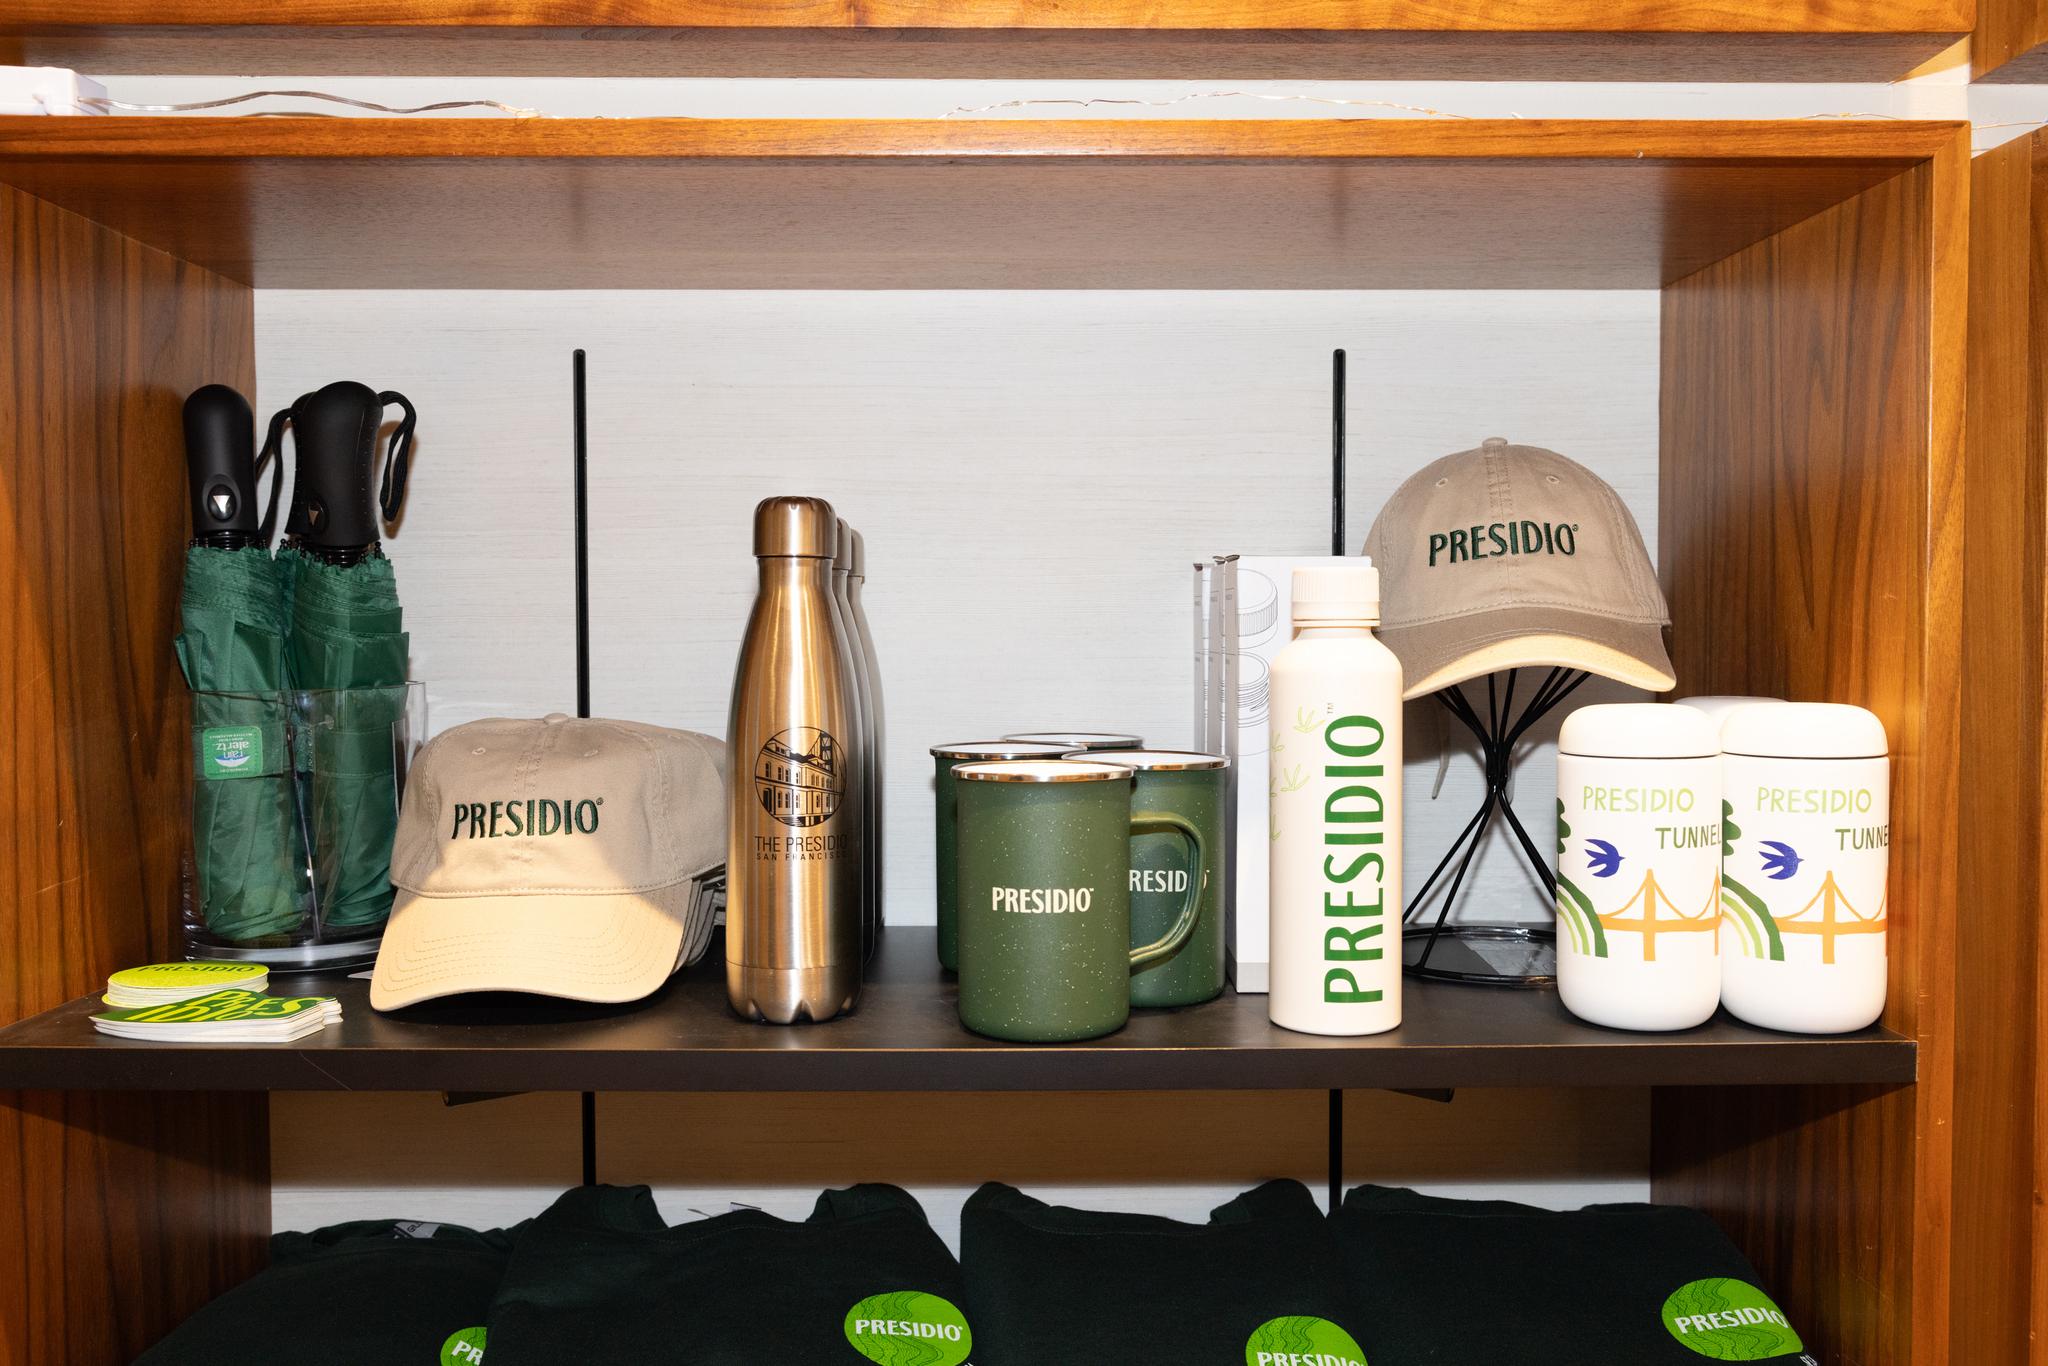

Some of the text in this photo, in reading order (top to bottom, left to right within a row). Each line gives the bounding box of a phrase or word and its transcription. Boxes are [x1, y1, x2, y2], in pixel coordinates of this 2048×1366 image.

[1583, 786, 1694, 813] PRESIDIO
[1757, 786, 1872, 814] PRESIDIO
[755, 835, 781, 852] THE
[1835, 824, 1888, 851] TUNNE
[756, 852, 776, 861] SAN
[1324, 715, 1384, 1003] PRESIDIO
[1129, 869, 1205, 893] RESID
